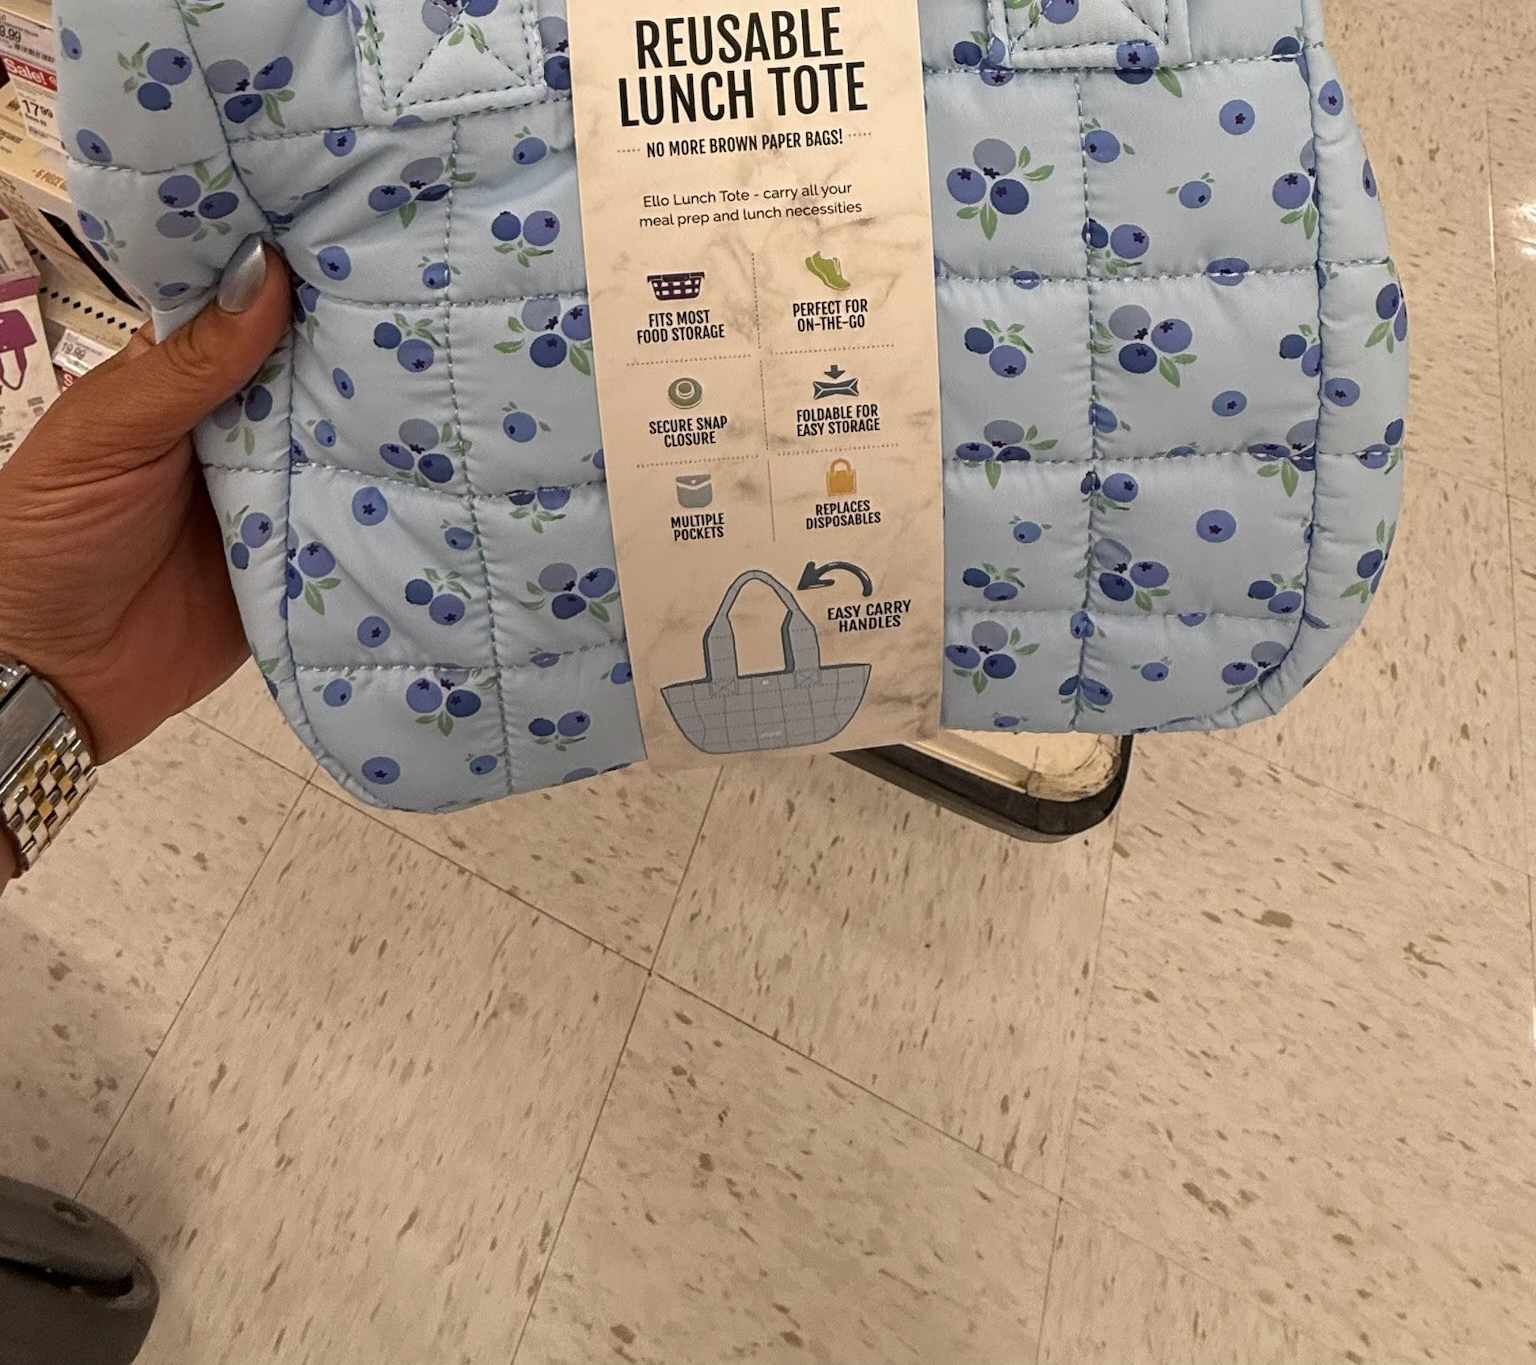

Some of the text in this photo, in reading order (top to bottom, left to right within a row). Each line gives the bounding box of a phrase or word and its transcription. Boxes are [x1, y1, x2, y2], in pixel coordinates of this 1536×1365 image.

[635, 6, 844, 69] REUSABLE
[3, 58, 47, 86] Sale!
[618, 61, 869, 127] LUNCH TOTE
[646, 128, 843, 158] NO MORE BROWN PAPER BAGS!
[643, 194, 670, 209] Ello
[673, 190, 716, 206] Lunch
[719, 188, 750, 204] Tote
[763, 187, 798, 204] carry
[801, 184, 819, 198] all
[820, 183, 852, 199] your
[639, 201, 863, 228] meal prep and lunch necessities
[792, 299, 868, 317] PERFECT FOR
[649, 309, 710, 327] FITS MOST
[797, 315, 866, 333] ON-THE-GO
[637, 324, 725, 345] FOOD STORAGE
[796, 404, 878, 423] FOLDABLE FOR
[649, 416, 728, 435] SECURE SNAP
[796, 418, 880, 437] EASY STORAGE
[663, 431, 717, 448] CLOSURE
[815, 500, 870, 516] REPLACES
[670, 512, 725, 529] MULTIPLE
[805, 512, 881, 530] DISPOSABLES
[673, 526, 724, 542] POCKETS
[827, 600, 912, 621] EASY CARRY
[838, 615, 901, 633] HANDLES
